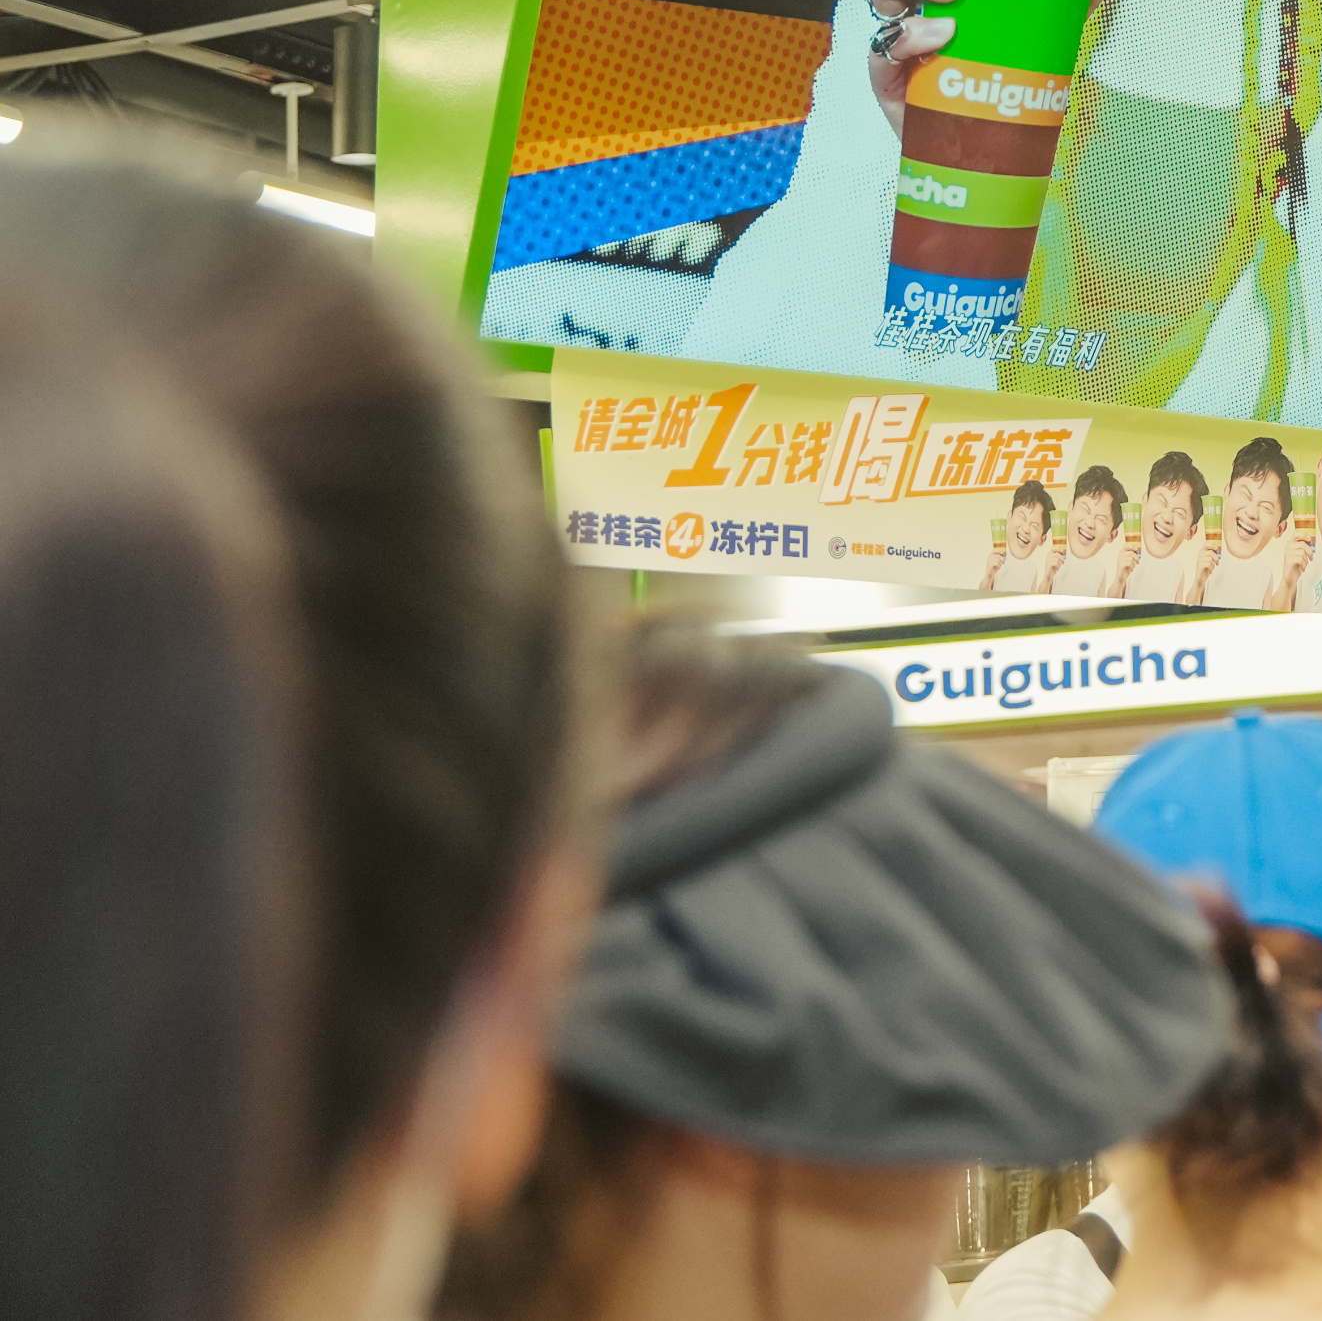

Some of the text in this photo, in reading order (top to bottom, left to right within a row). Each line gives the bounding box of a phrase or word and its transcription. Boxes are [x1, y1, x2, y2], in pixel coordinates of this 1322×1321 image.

[874, 305, 1107, 372] 桂桂茶现在有福利
[851, 541, 942, 560] 桂桂茶 Guiguicha
[895, 643, 1208, 710] Guiguicha
